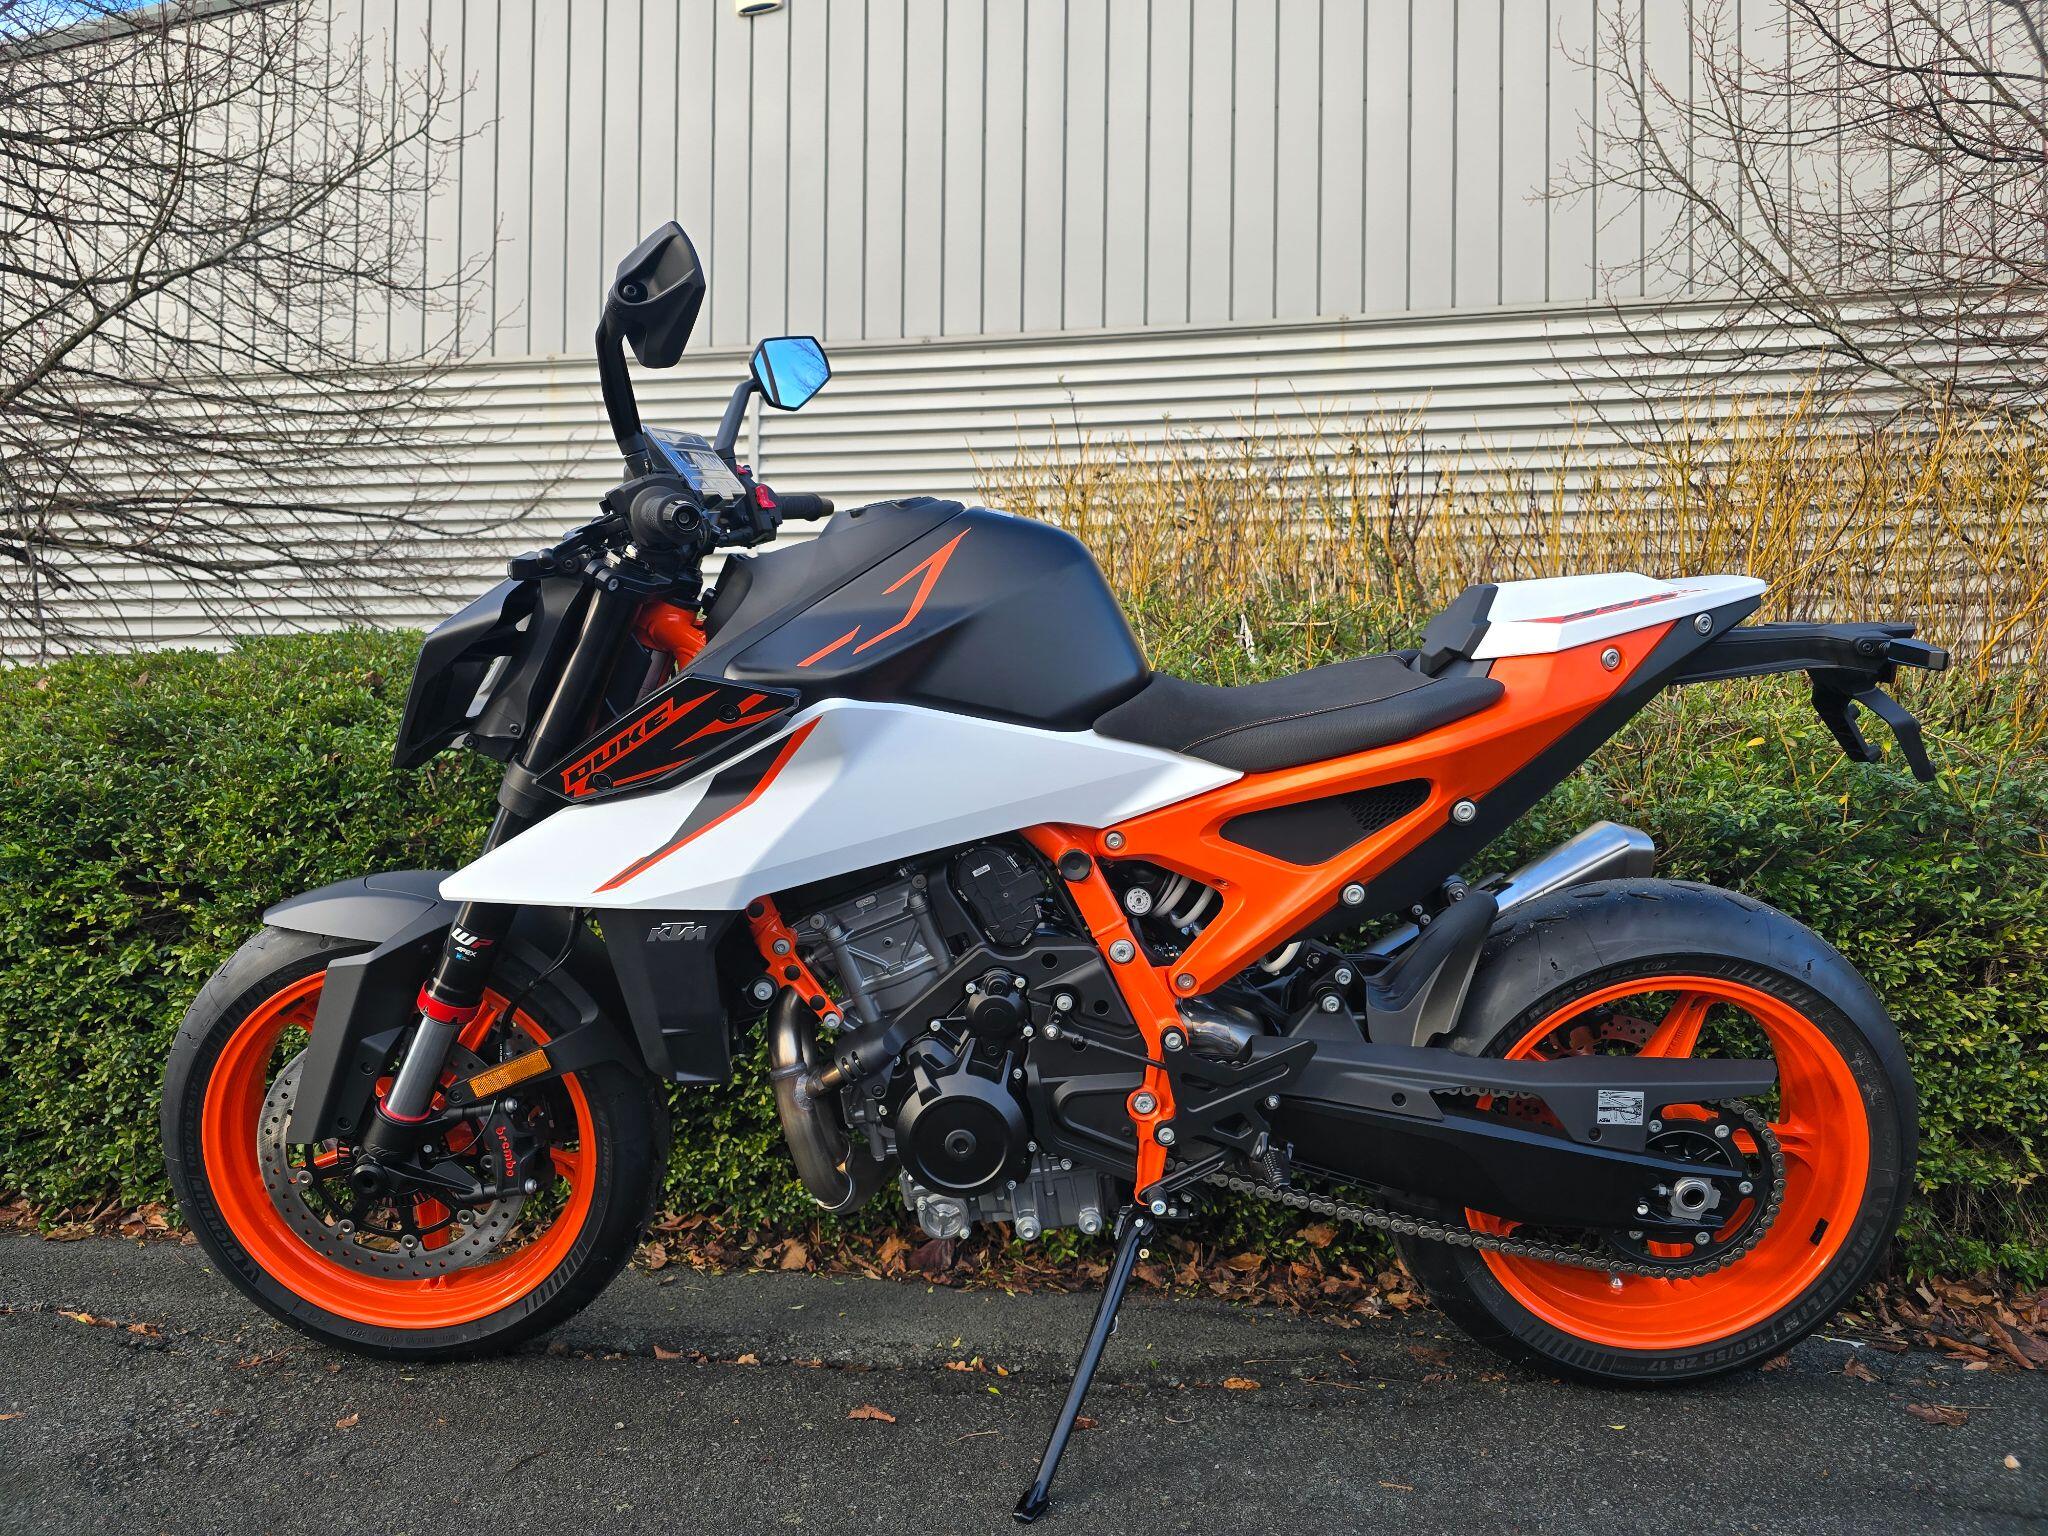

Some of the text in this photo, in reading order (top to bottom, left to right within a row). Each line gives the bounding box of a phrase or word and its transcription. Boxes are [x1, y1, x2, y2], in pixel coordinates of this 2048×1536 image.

[567, 703, 671, 789] DUKE
[450, 927, 495, 949] WP
[646, 921, 708, 942] KTM
[454, 946, 478, 958] APEX
[495, 1124, 518, 1178] brembo
[191, 1178, 245, 1263] MICHELIN
[1784, 1226, 1878, 1333] MICHELIN
[1647, 1360, 1667, 1372] 17
[1673, 1356, 1698, 1369] ZR
